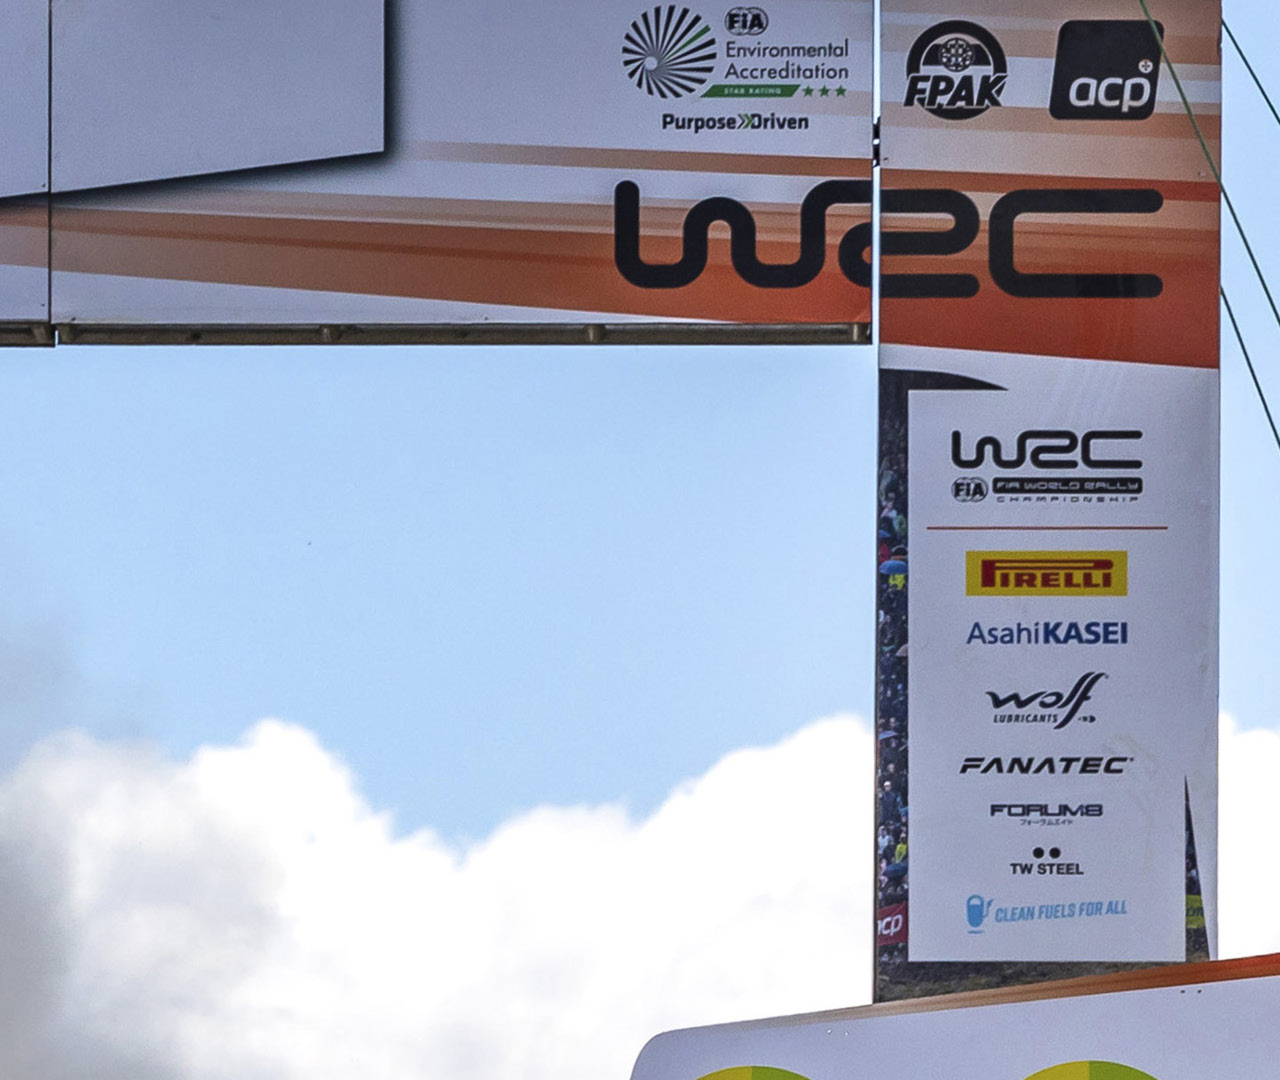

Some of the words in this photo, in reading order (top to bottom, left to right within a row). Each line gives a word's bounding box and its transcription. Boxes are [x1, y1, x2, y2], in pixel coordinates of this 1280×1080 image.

[727, 9, 766, 32] FIA
[725, 38, 849, 58] Environmental
[724, 61, 849, 80] Accreditation
[903, 74, 1007, 109] FPAK
[1068, 75, 1151, 112] acp
[662, 113, 737, 133] Purpose
[750, 113, 809, 130] Driven
[614, 180, 1163, 298] WRC
[951, 430, 1143, 469] WRC
[954, 483, 985, 497] FIA
[996, 481, 1020, 489] FIA
[1024, 481, 1080, 490] WORLD
[1084, 481, 1139, 490] RALLY
[981, 559, 1114, 588] PIRELLI
[985, 671, 1107, 730] Wolf
[993, 714, 1059, 724] LUBRICANTS
[959, 757, 1129, 774] FANATEC
[990, 804, 1104, 817] FORUM8
[1010, 863, 1034, 875] TW
[1037, 863, 1084, 875] STEEL
[995, 906, 1035, 923] CLEAN
[1038, 904, 1075, 919] FUELS
[1079, 901, 1103, 917] FOR
[1105, 899, 1128, 915] ALL
[877, 914, 903, 936] cp
